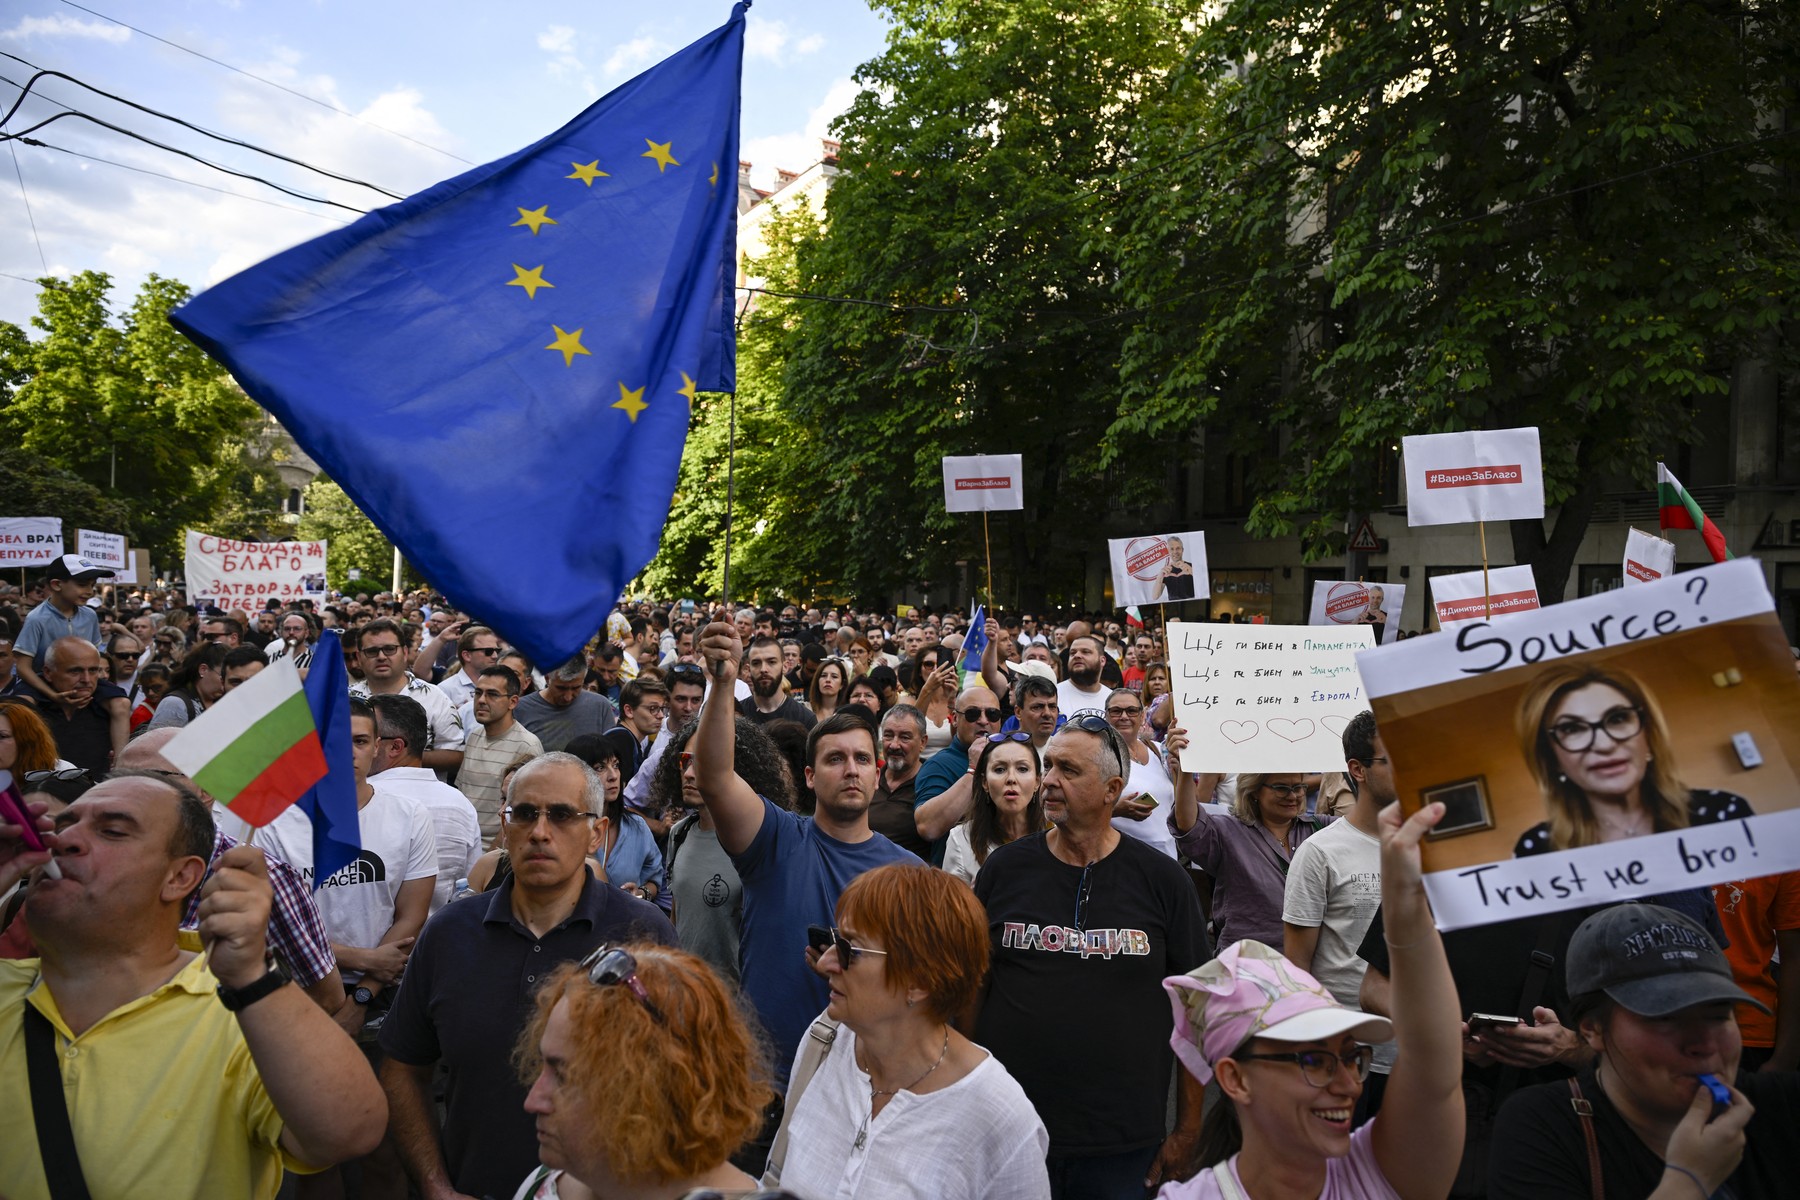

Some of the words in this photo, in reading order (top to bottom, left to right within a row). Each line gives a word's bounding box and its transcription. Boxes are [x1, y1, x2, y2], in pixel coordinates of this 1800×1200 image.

[957, 480, 1009, 488] #ВарнаЗаБлаго
[1430, 470, 1517, 485] #ВарнаЗаБлаго
[27, 535, 62, 543] ВРАТ
[199, 535, 303, 557] СВОБОДА
[307, 542, 323, 559] ЗА
[222, 554, 302, 573] БЛАГО
[210, 579, 278, 597] ЗАТВОР
[281, 584, 304, 597] ЗА
[1326, 592, 1368, 609] ДИМИТРОВГРАД
[1440, 597, 1536, 616] #ДимитроврадЗаБлаго
[1455, 576, 1709, 674] Source?
[1184, 632, 1223, 656] ЩЕ
[1254, 641, 1283, 652] БИЕМ
[1183, 663, 1220, 683] ЩЕ
[1254, 668, 1283, 677] БИЕМ
[1183, 693, 1219, 710] ЩЕ
[1256, 695, 1282, 705] БИЕМ
[1458, 862, 1588, 907] Trust
[1604, 859, 1649, 889] me
[1677, 818, 1758, 875] bro!
[321, 873, 358, 889] FACE
[1002, 922, 1150, 960] ПЛОВДИВ
[1623, 925, 1668, 960] NEW
